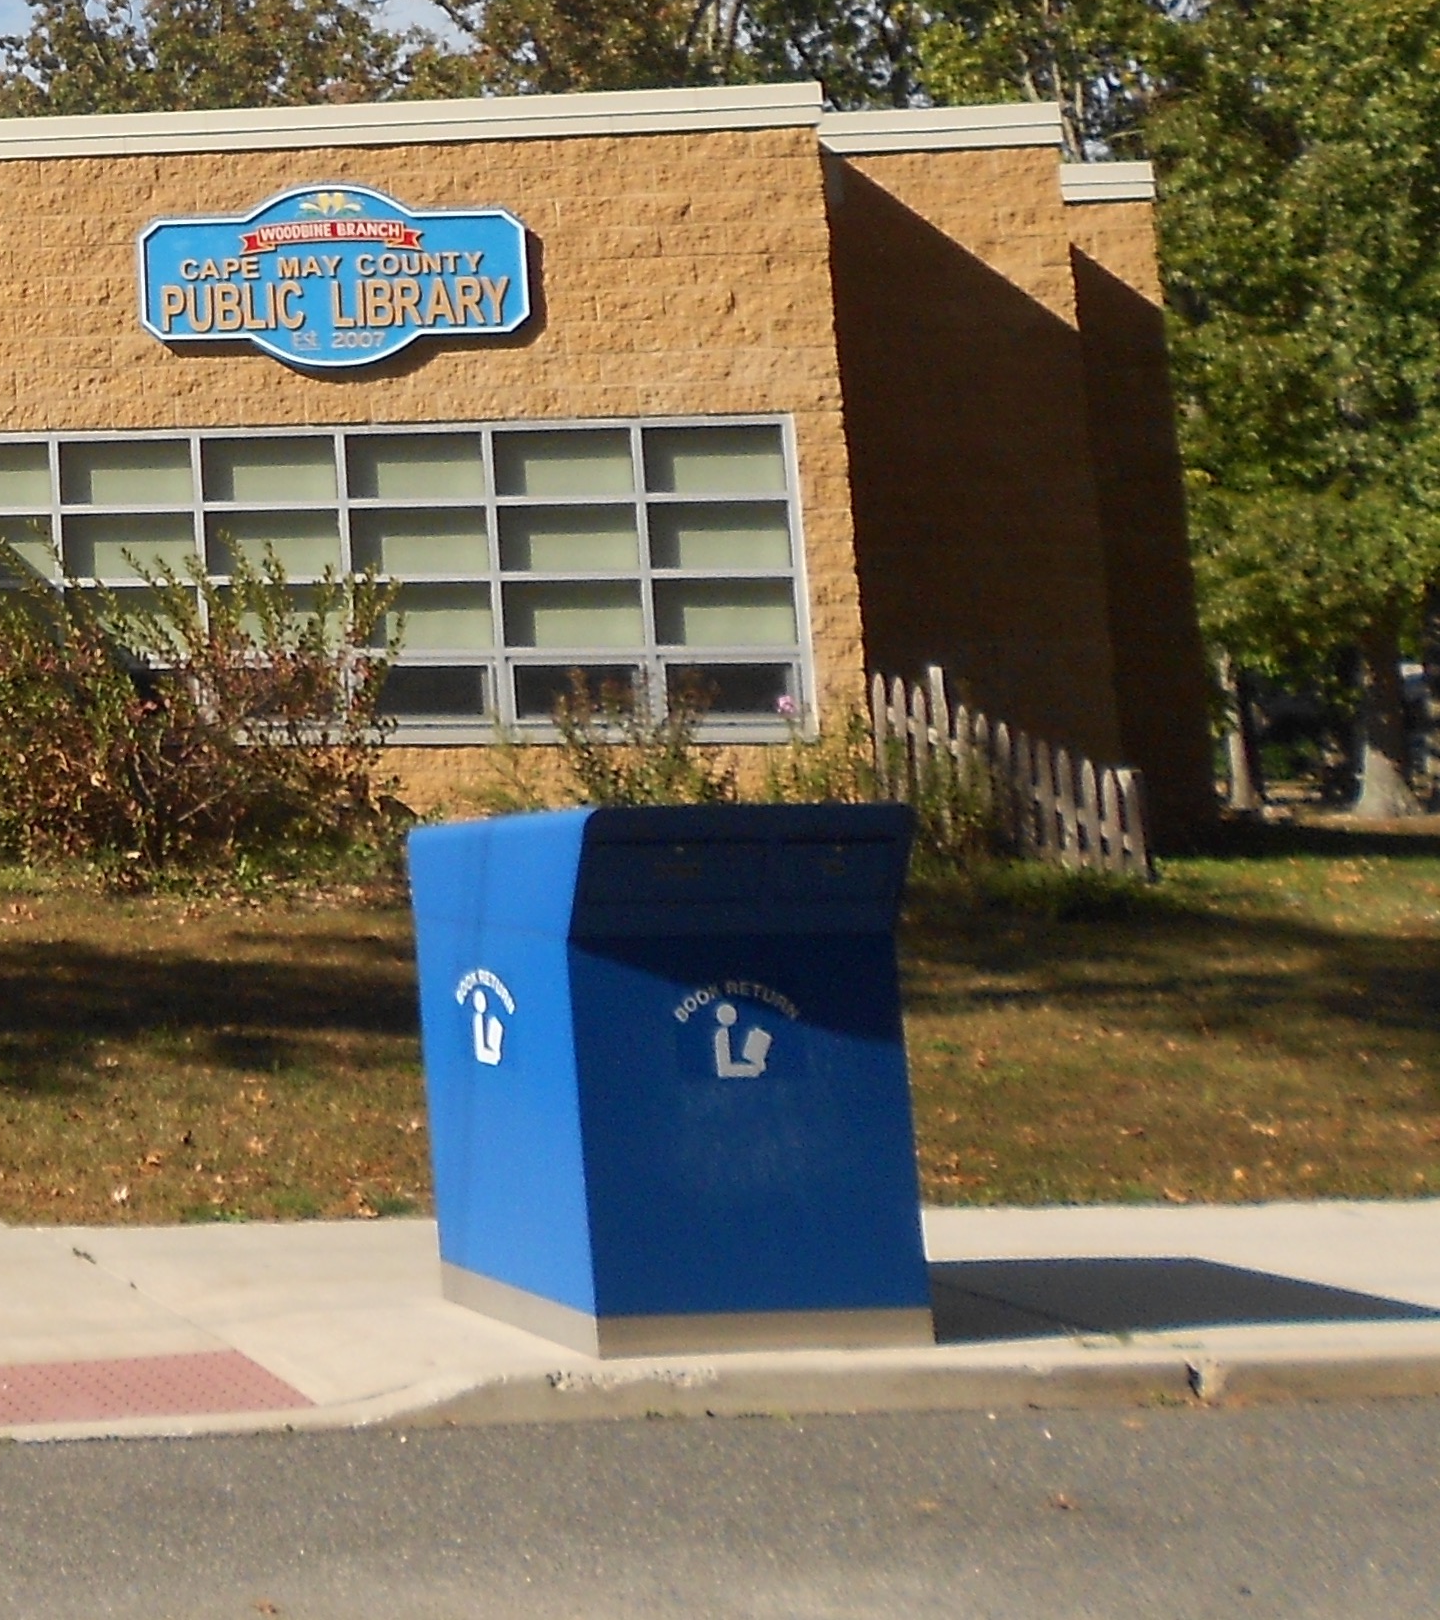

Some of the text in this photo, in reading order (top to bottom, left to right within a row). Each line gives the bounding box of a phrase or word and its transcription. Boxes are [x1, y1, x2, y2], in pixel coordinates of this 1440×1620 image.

[260, 222, 401, 241] WOODBINE BRANCH
[180, 252, 483, 280] CAPE MAY COUNTY
[161, 277, 509, 332] PUBLIC LIBRARY
[331, 331, 385, 348] 2007
[456, 969, 514, 1015] BOOK RETURN
[674, 980, 799, 1022] BOOK RETURN
